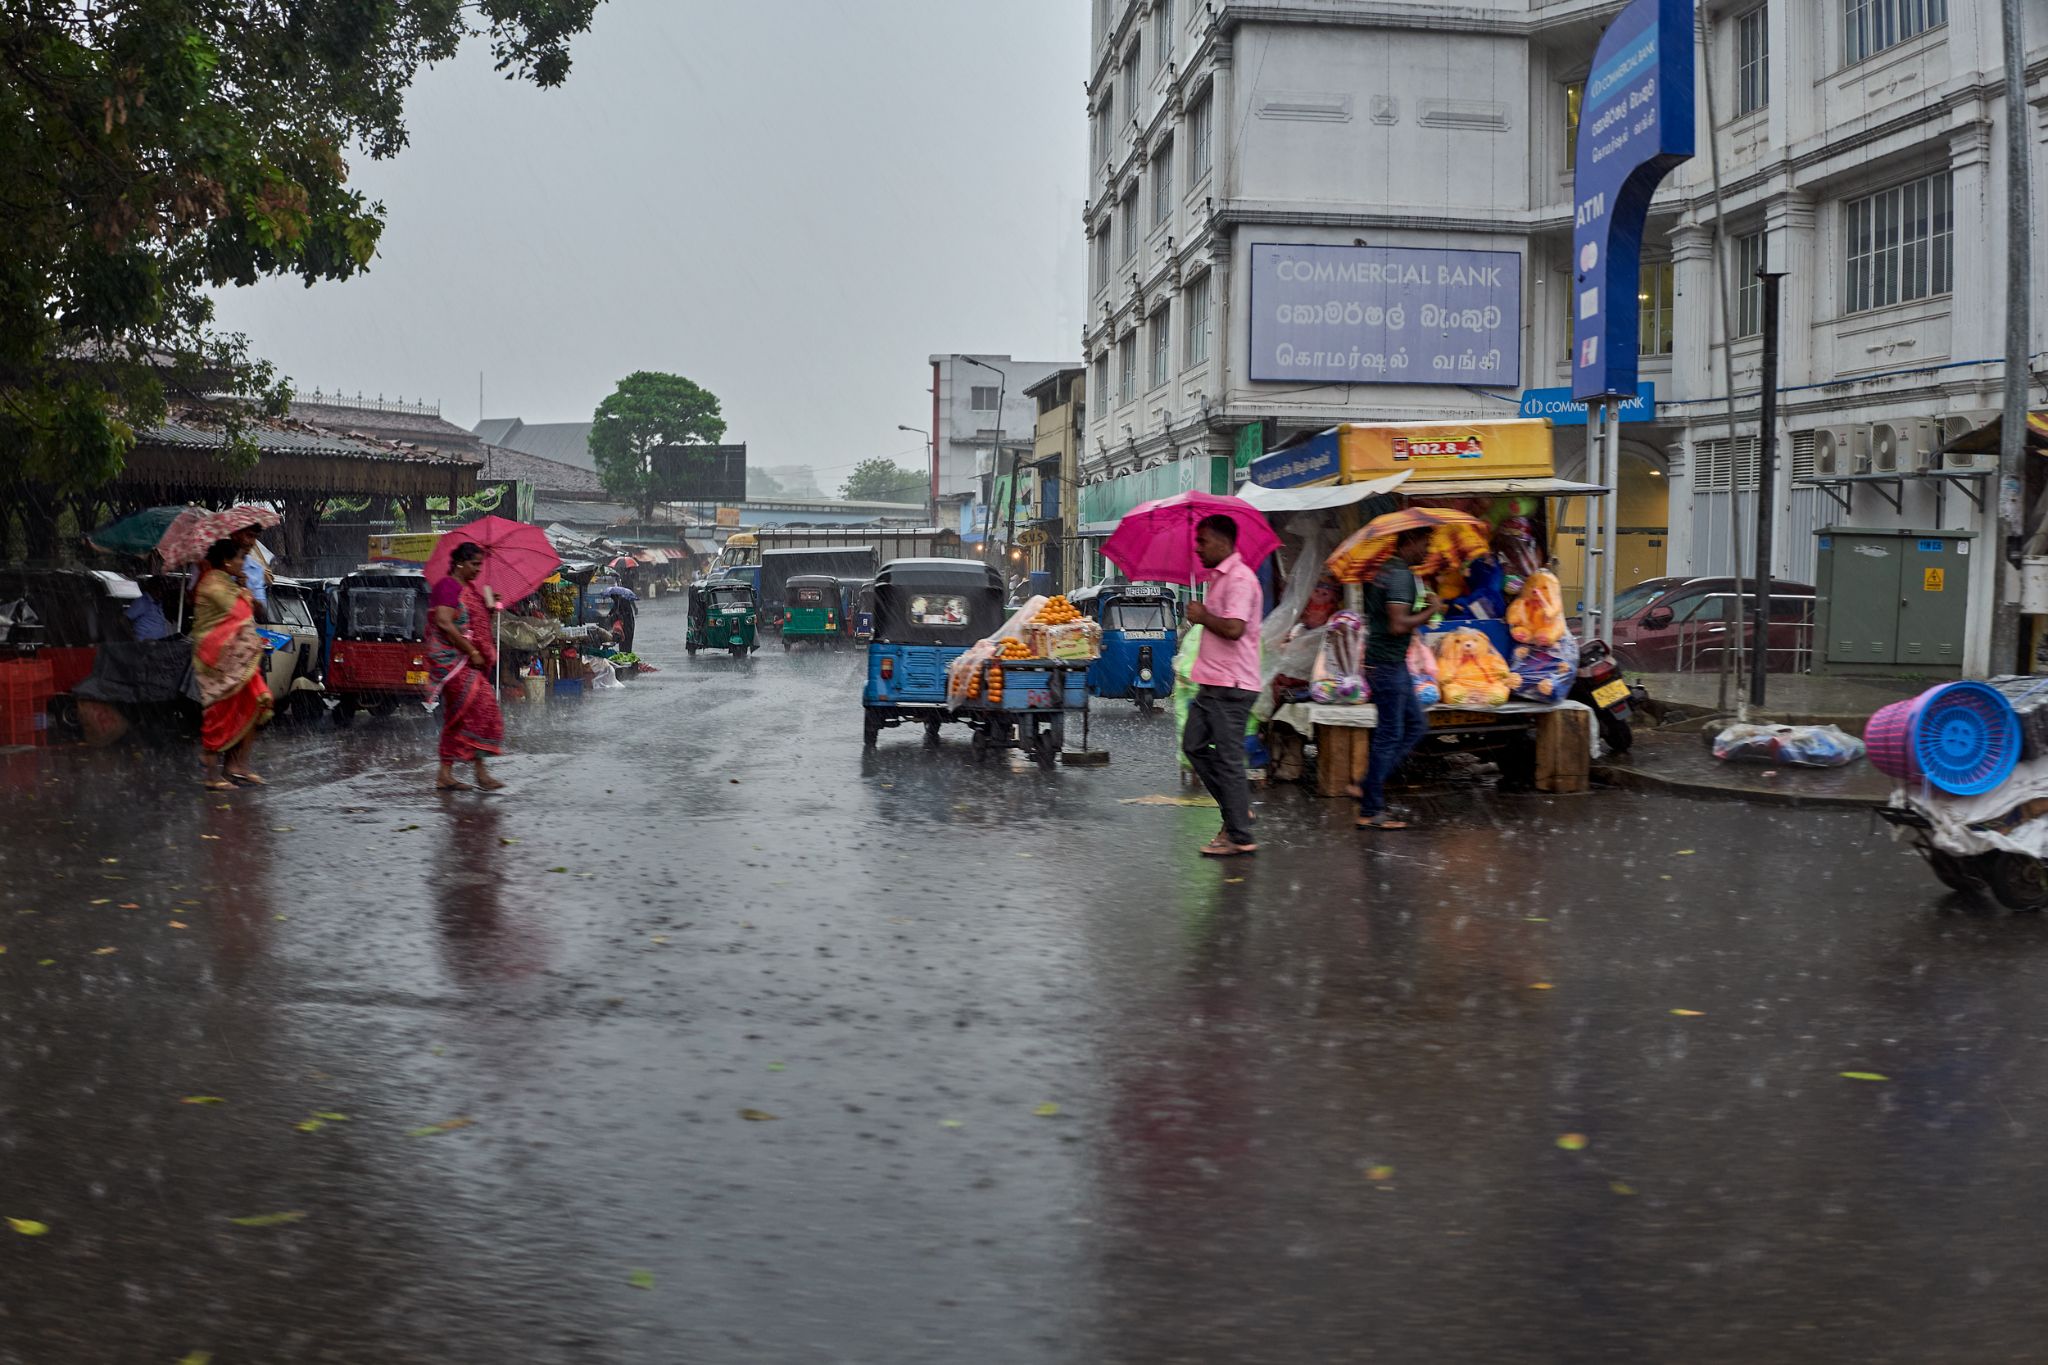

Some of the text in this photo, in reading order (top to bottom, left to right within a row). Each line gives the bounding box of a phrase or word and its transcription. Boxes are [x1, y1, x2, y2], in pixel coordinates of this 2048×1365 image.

[1575, 192, 1604, 229] ATM
[1276, 260, 1502, 287] COMMERCIAL BANK
[1432, 348, 1501, 371] வங்கி
[1410, 442, 1457, 455] 102.8
[1126, 587, 1160, 596] METERED TAXI
